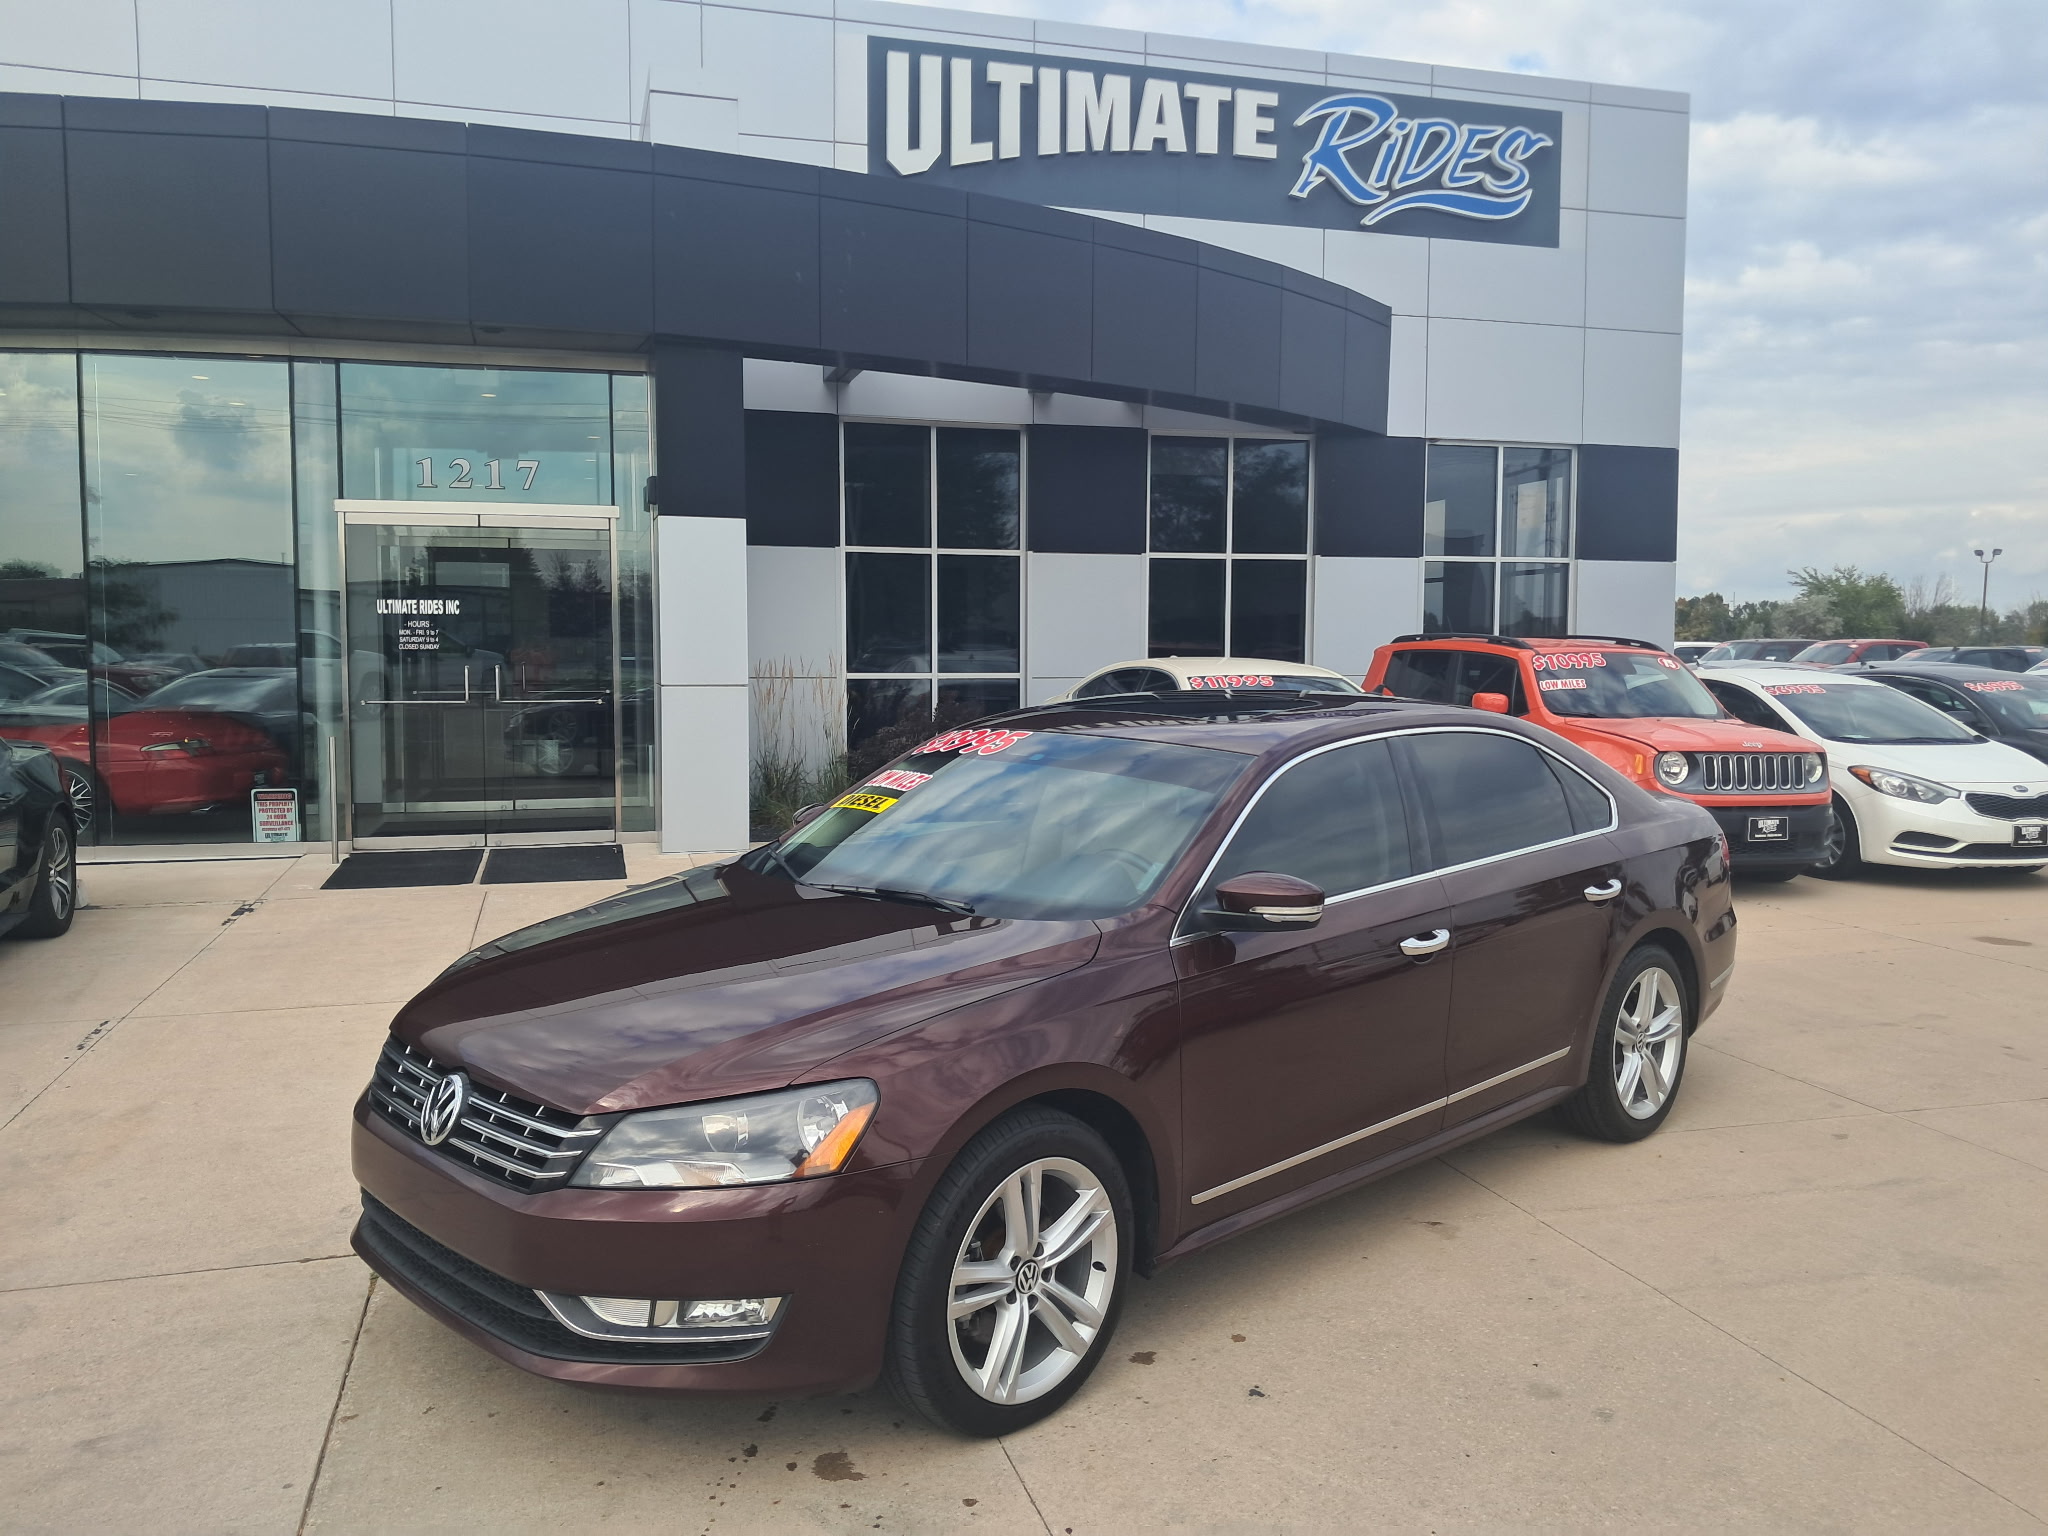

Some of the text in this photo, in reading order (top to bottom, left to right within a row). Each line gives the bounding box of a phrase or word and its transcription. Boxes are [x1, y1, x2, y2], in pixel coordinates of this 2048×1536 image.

[886, 51, 1279, 176] ULTIMATE
[416, 456, 540, 490] 1217
[376, 599, 460, 615] ULTIMATE RIDES INC
[407, 620, 430, 628] HOURS
[1532, 652, 1607, 671] $10995
[1189, 675, 1275, 690] $11995
[1539, 678, 1587, 691] LOW MILES
[838, 793, 889, 810] DIESEL
